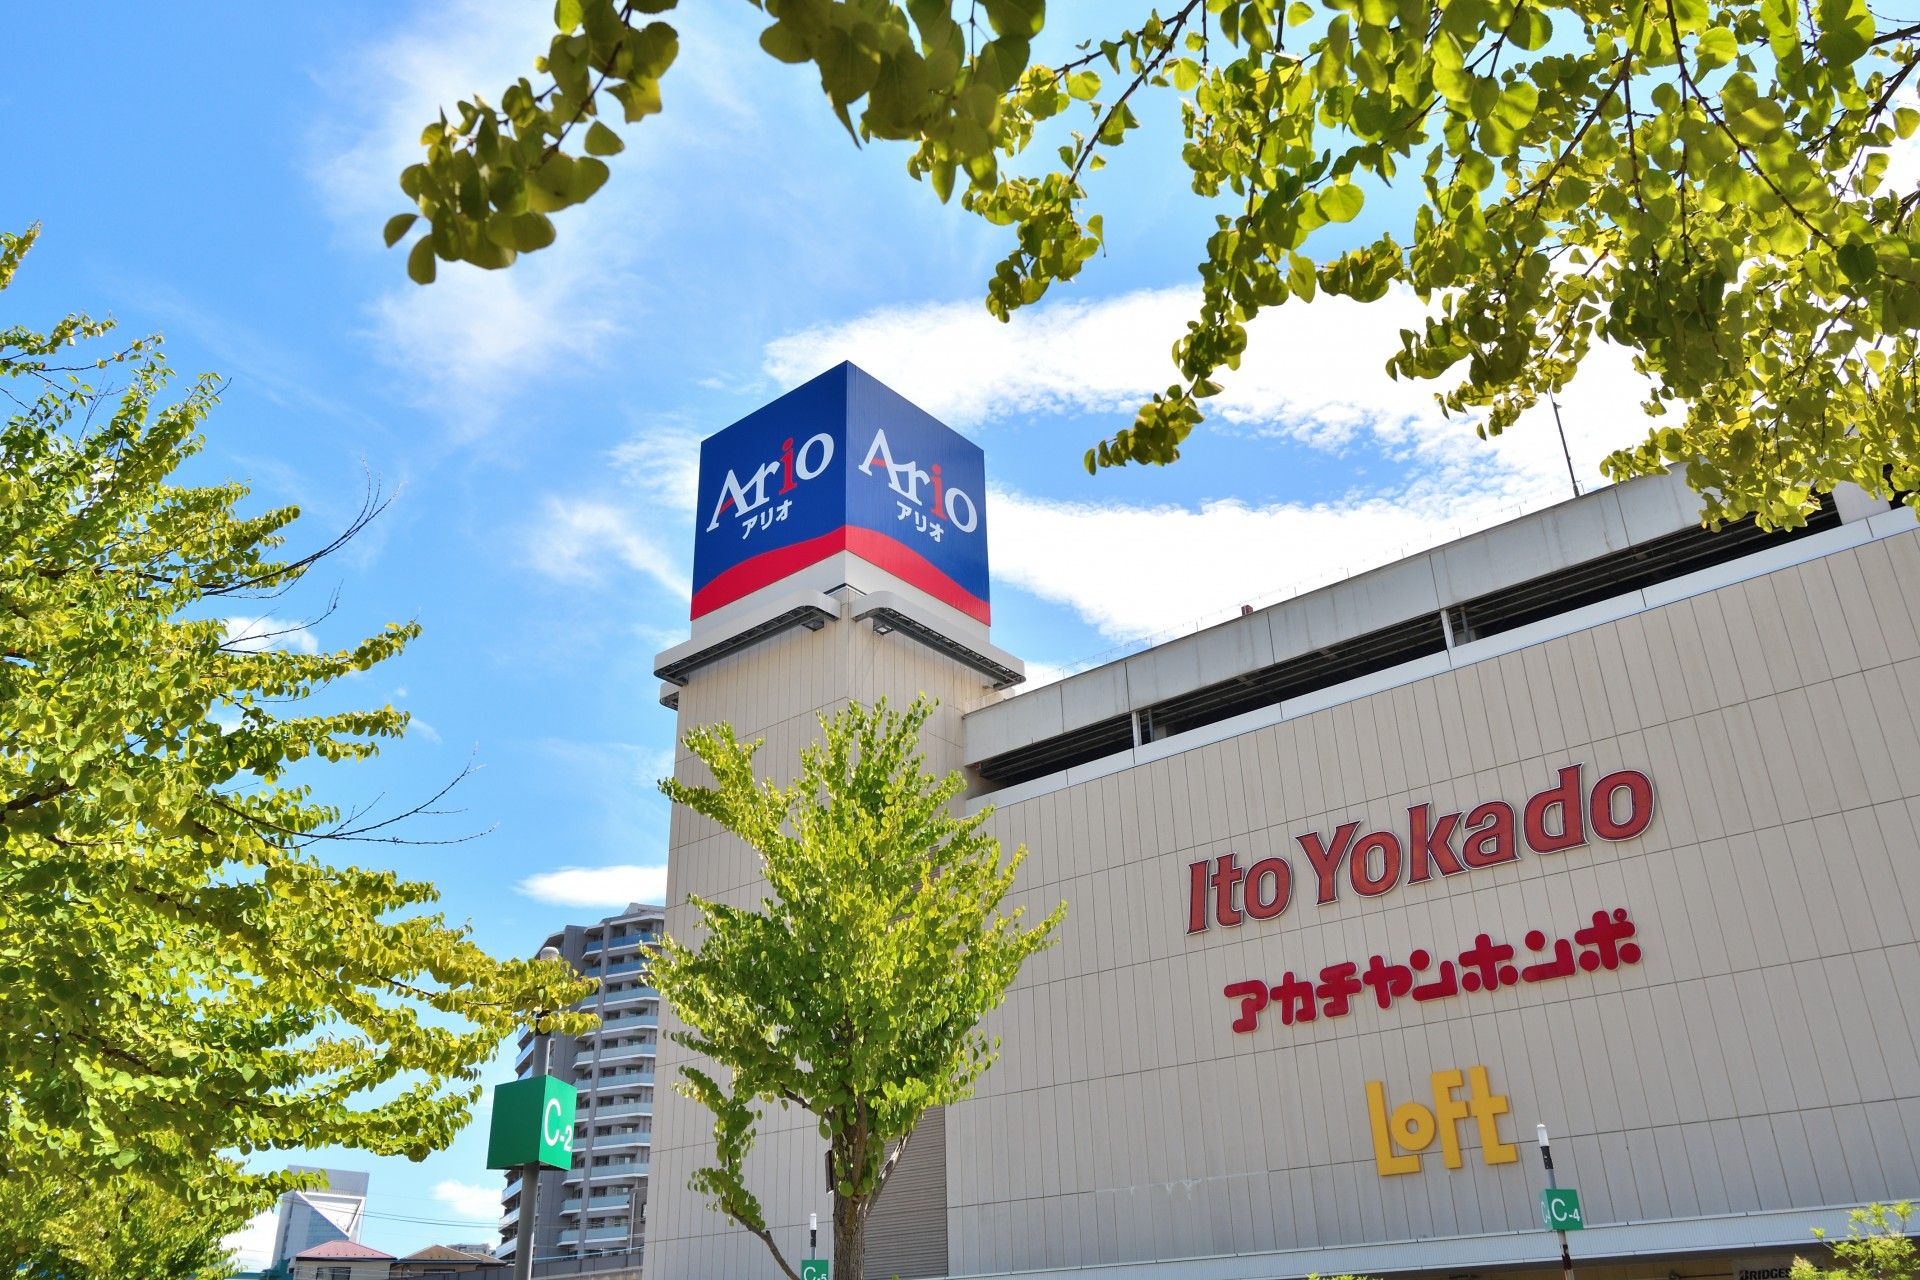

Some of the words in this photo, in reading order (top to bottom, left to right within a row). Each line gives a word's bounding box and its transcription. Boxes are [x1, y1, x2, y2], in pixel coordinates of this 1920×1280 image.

[706, 432, 835, 533] Ario
[858, 428, 978, 533] Ario
[742, 499, 793, 540] アリオ
[896, 502, 945, 543] アリオ
[1223, 906, 1643, 1034] アカチャンホンポ
[544, 1098, 573, 1153] C-2
[1551, 1198, 1581, 1222] C-4
